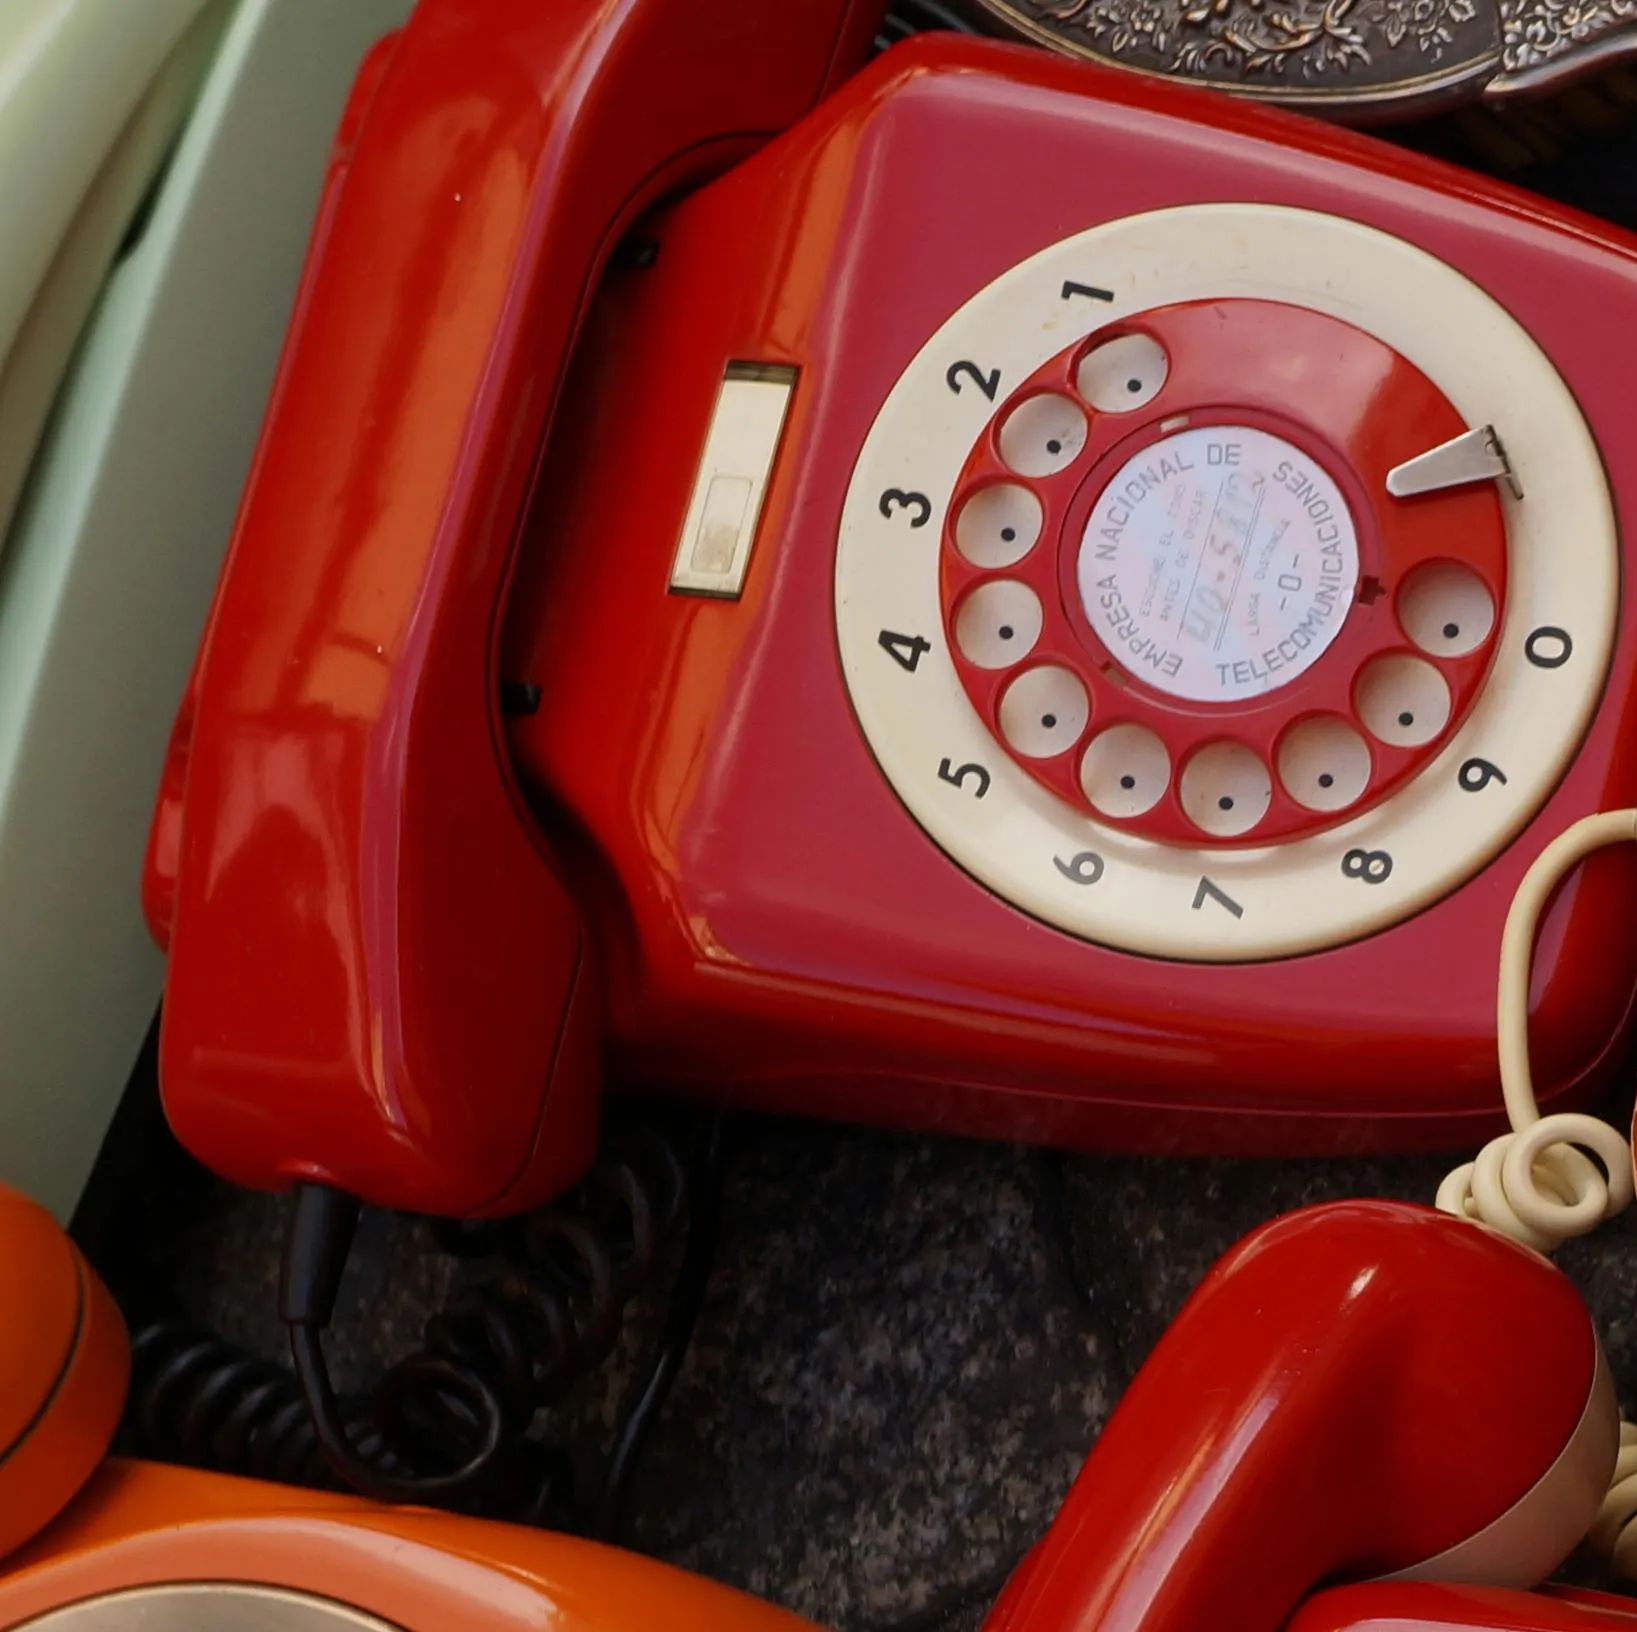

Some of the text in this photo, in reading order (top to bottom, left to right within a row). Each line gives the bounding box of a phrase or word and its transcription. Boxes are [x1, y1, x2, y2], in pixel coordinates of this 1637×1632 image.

[878, 281, 1573, 920] 1 2 3 4 5 6 7 8 9 0
[1095, 443, 1343, 686] EMPRESA NACIONAL DE TELECOMUNICACIONES
